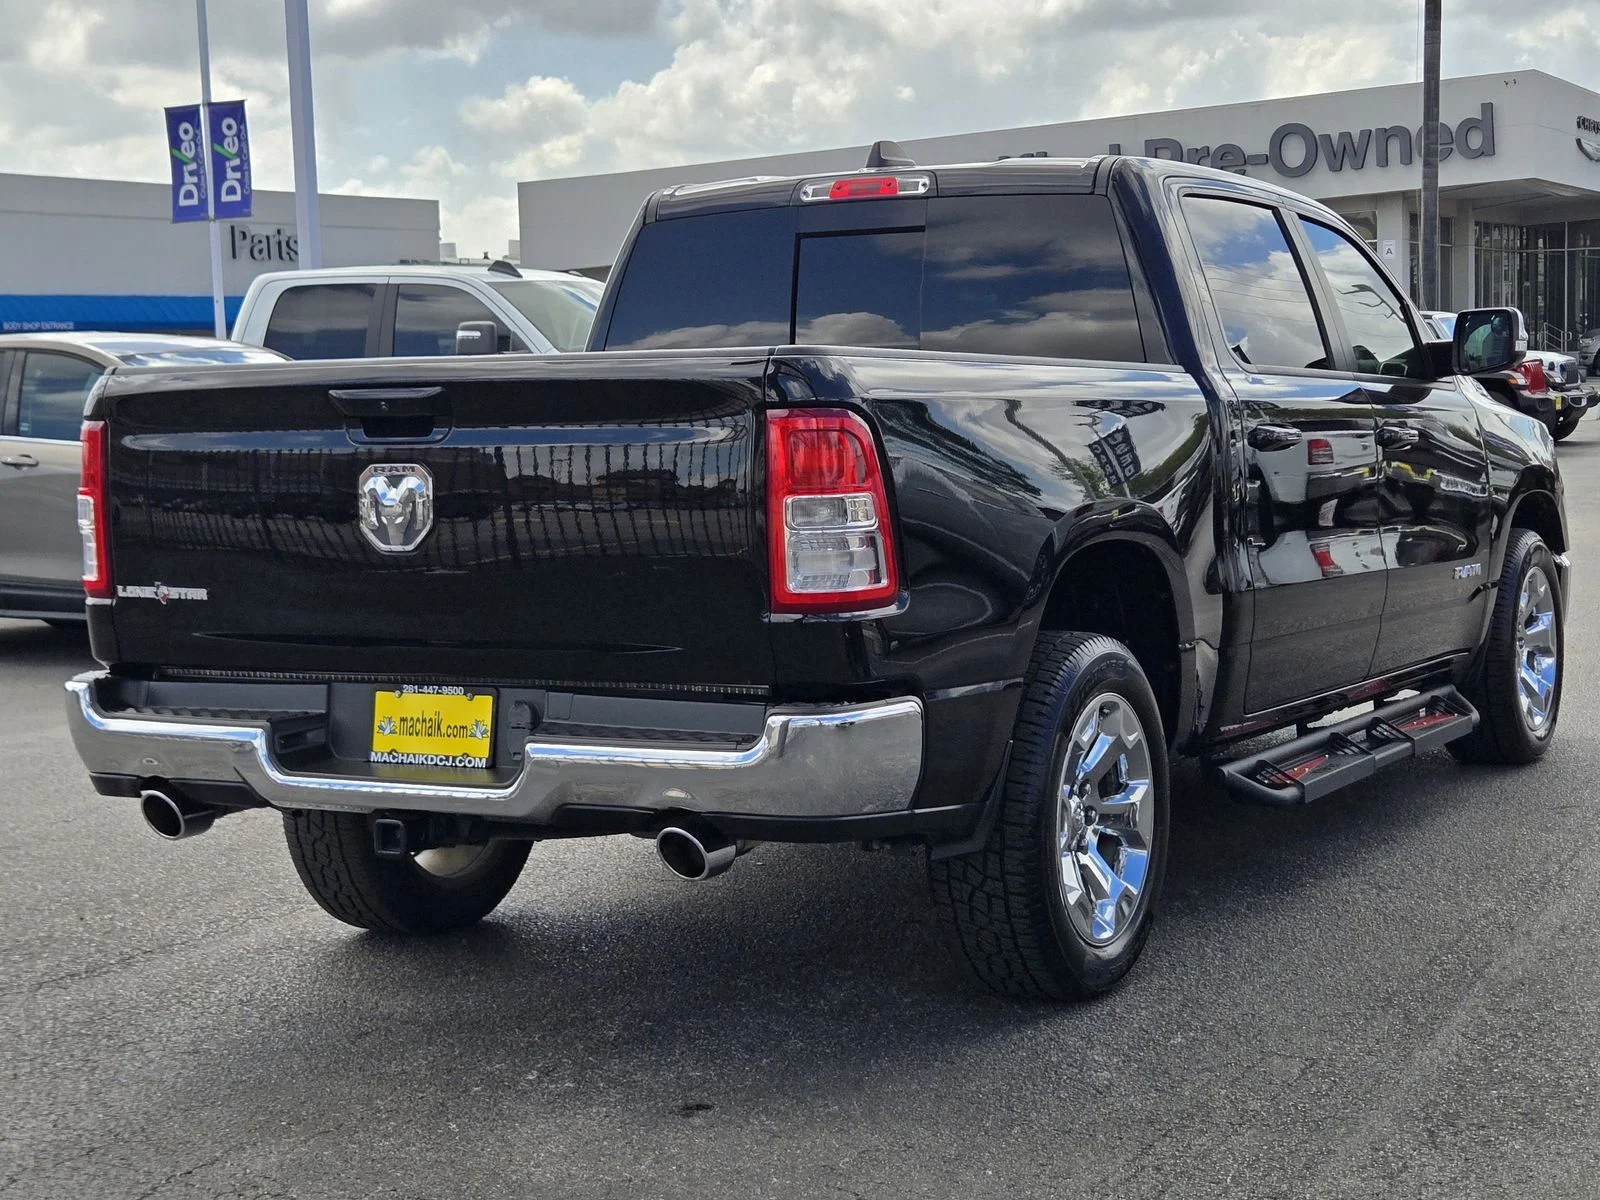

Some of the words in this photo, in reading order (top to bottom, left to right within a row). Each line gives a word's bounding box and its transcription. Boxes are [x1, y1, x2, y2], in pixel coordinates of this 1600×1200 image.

[116, 585, 156, 598] LONE
[168, 587, 208, 600] STAR
[402, 684, 464, 695] 281-447-9500
[399, 710, 468, 739] machaik.com
[370, 751, 486, 768] MACHAIKDCJ.COM
